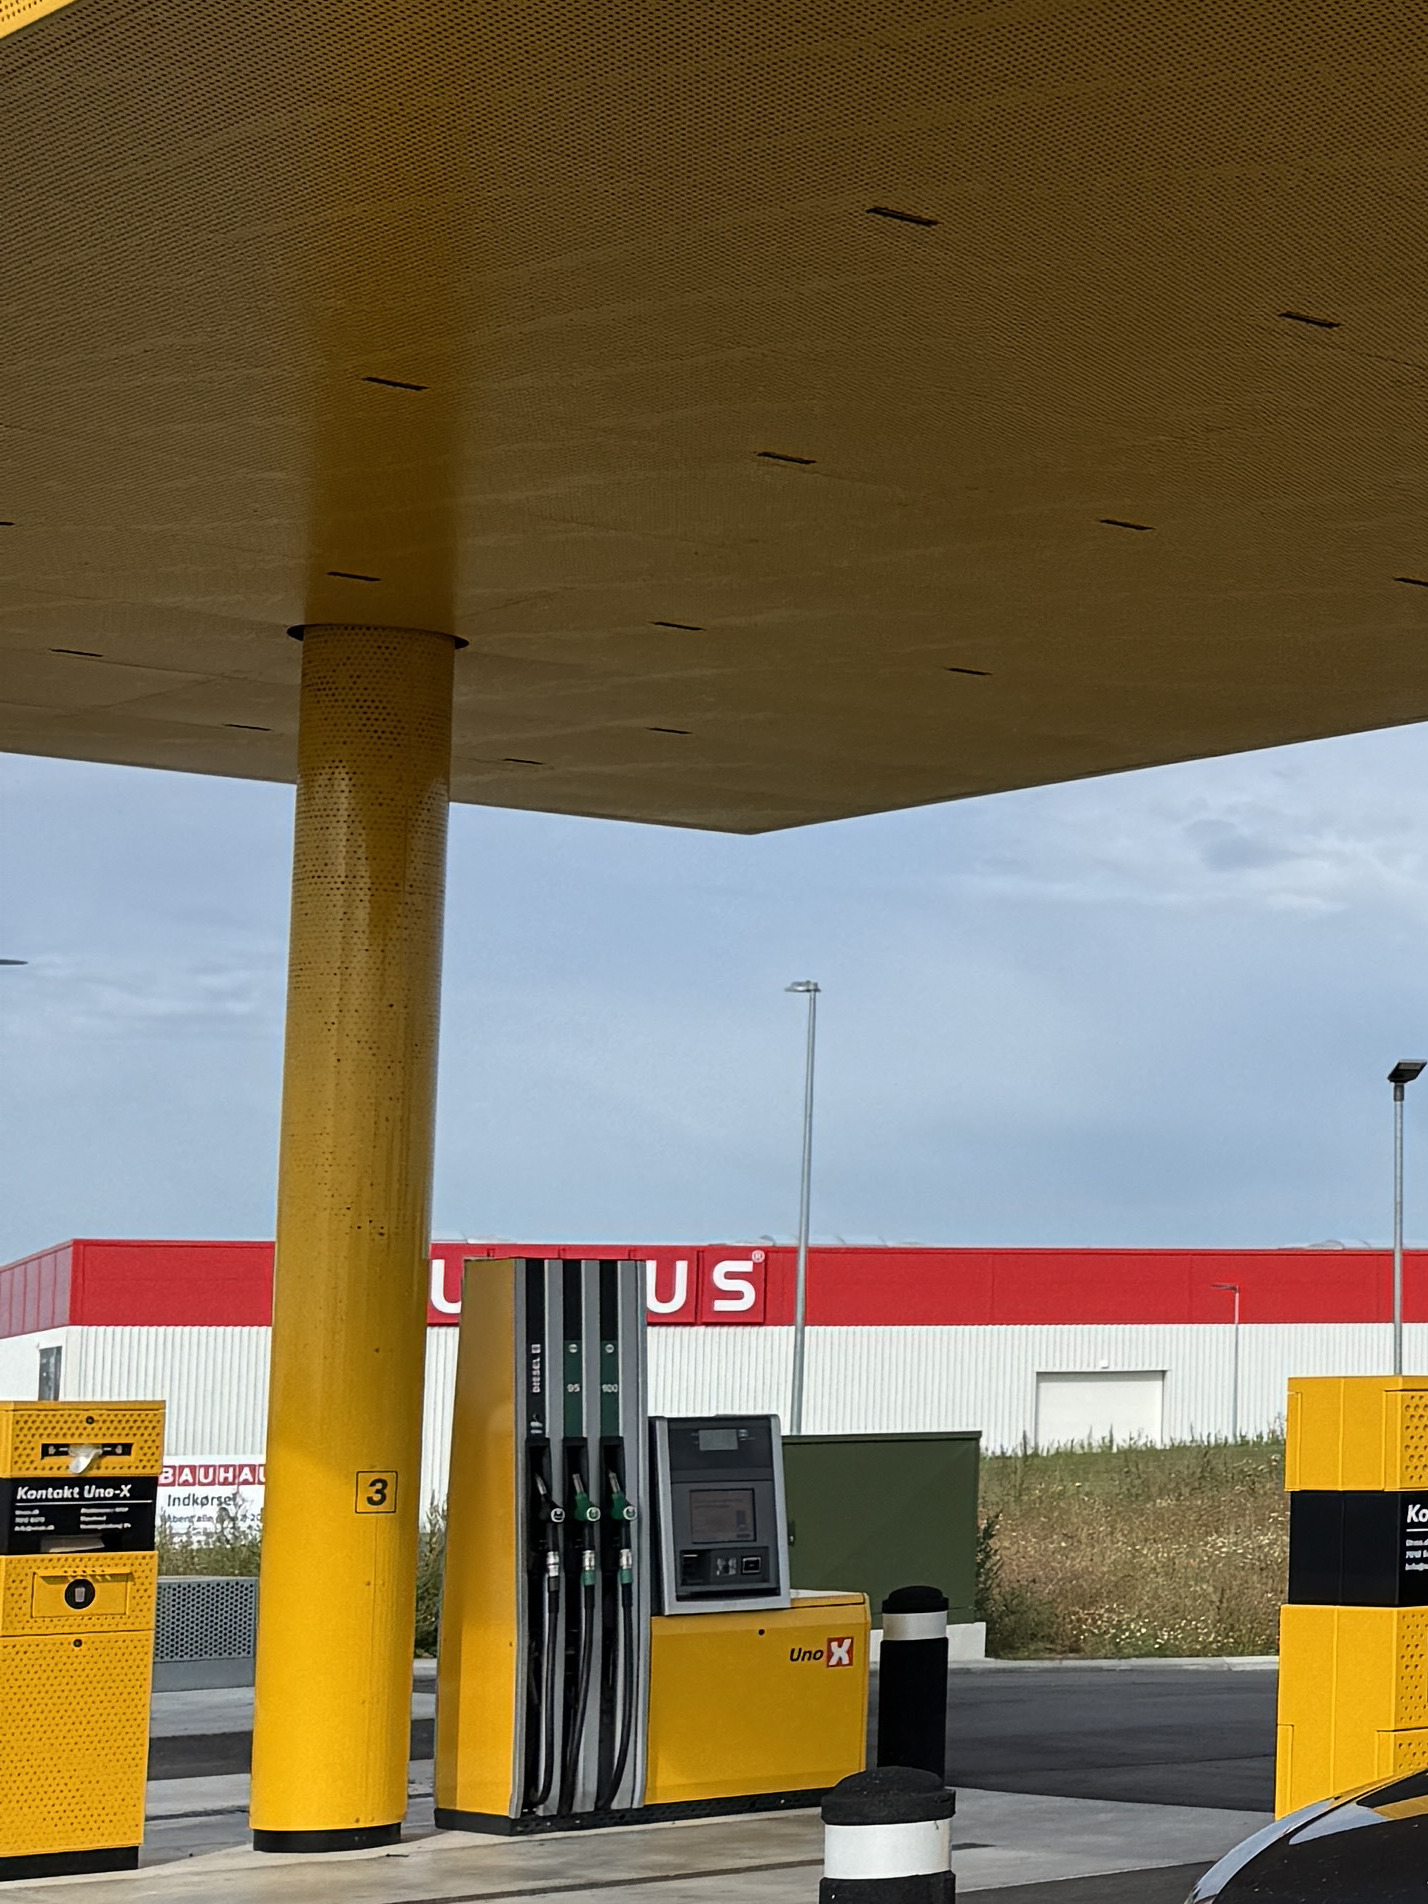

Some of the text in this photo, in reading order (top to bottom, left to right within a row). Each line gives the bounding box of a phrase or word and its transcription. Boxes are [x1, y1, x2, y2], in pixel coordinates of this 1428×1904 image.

[16, 1483, 132, 1500] Kontakt Uno-X
[366, 1477, 389, 1506] 3
[789, 1638, 852, 1666] Uno X
